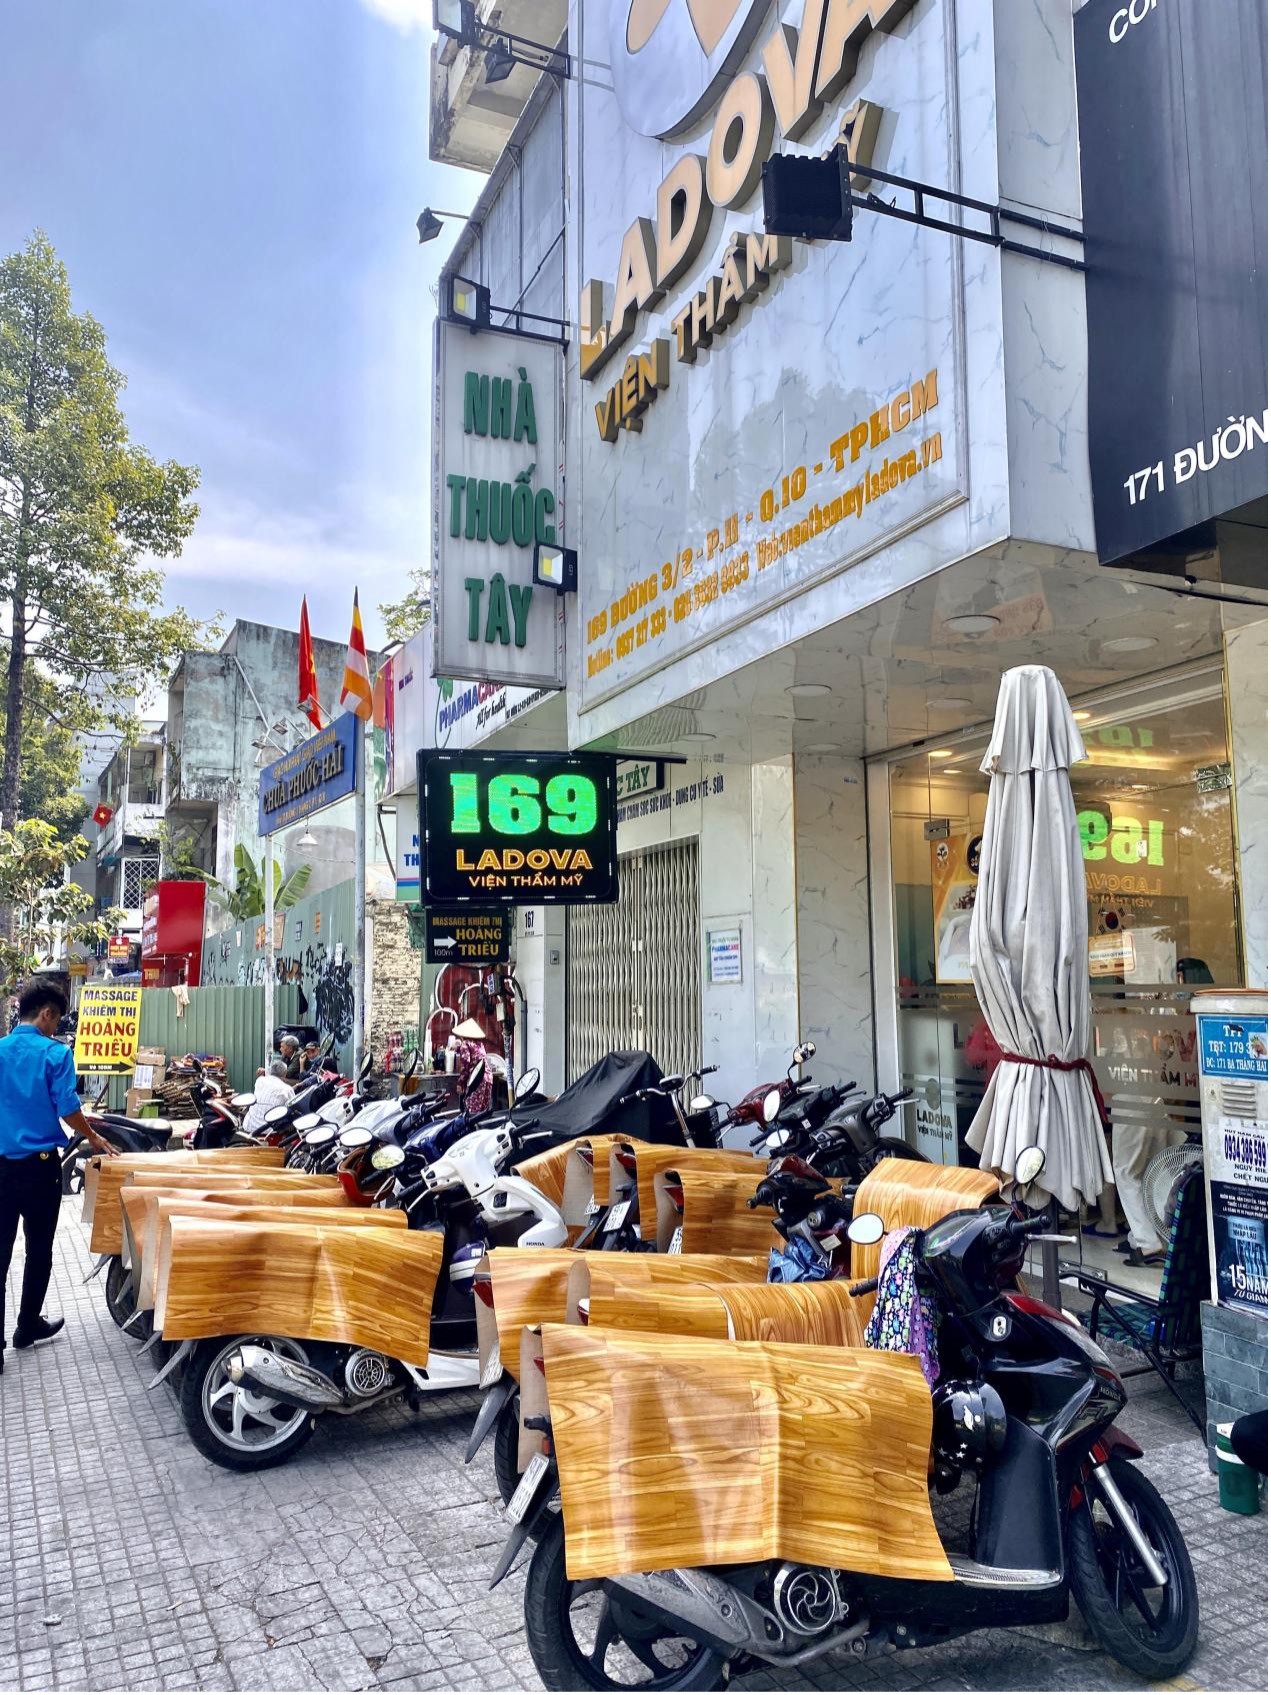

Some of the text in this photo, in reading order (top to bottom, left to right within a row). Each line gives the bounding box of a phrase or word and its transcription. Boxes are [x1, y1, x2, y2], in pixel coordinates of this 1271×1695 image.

[464, 367, 537, 444] NHÀ
[1123, 461, 1165, 505] 171
[447, 463, 556, 548] THUỐC
[587, 589, 607, 644] 169
[760, 466, 806, 523] Q.10
[830, 368, 938, 472] TPHCM
[464, 572, 533, 648] TÂY
[625, 764, 650, 793] TÂY
[450, 773, 597, 836] 169
[456, 848, 593, 871] LADOVA
[469, 871, 584, 890] VIỆN THẨM MỸ
[525, 910, 534, 929] 167
[84, 990, 138, 1001] MASSAGE
[120, 1006, 136, 1019] THỊ
[79, 1018, 136, 1037] HOÀNG
[80, 1038, 132, 1057] TRIỀU
[1229, 1041, 1244, 1054] 179
[1108, 1062, 1138, 1086] VIỆN
[1256, 1060, 1267, 1072] HAI
[1224, 1134, 1240, 1162] 0934
[1253, 1139, 1267, 1168] 599
[1229, 1264, 1246, 1290] 15
